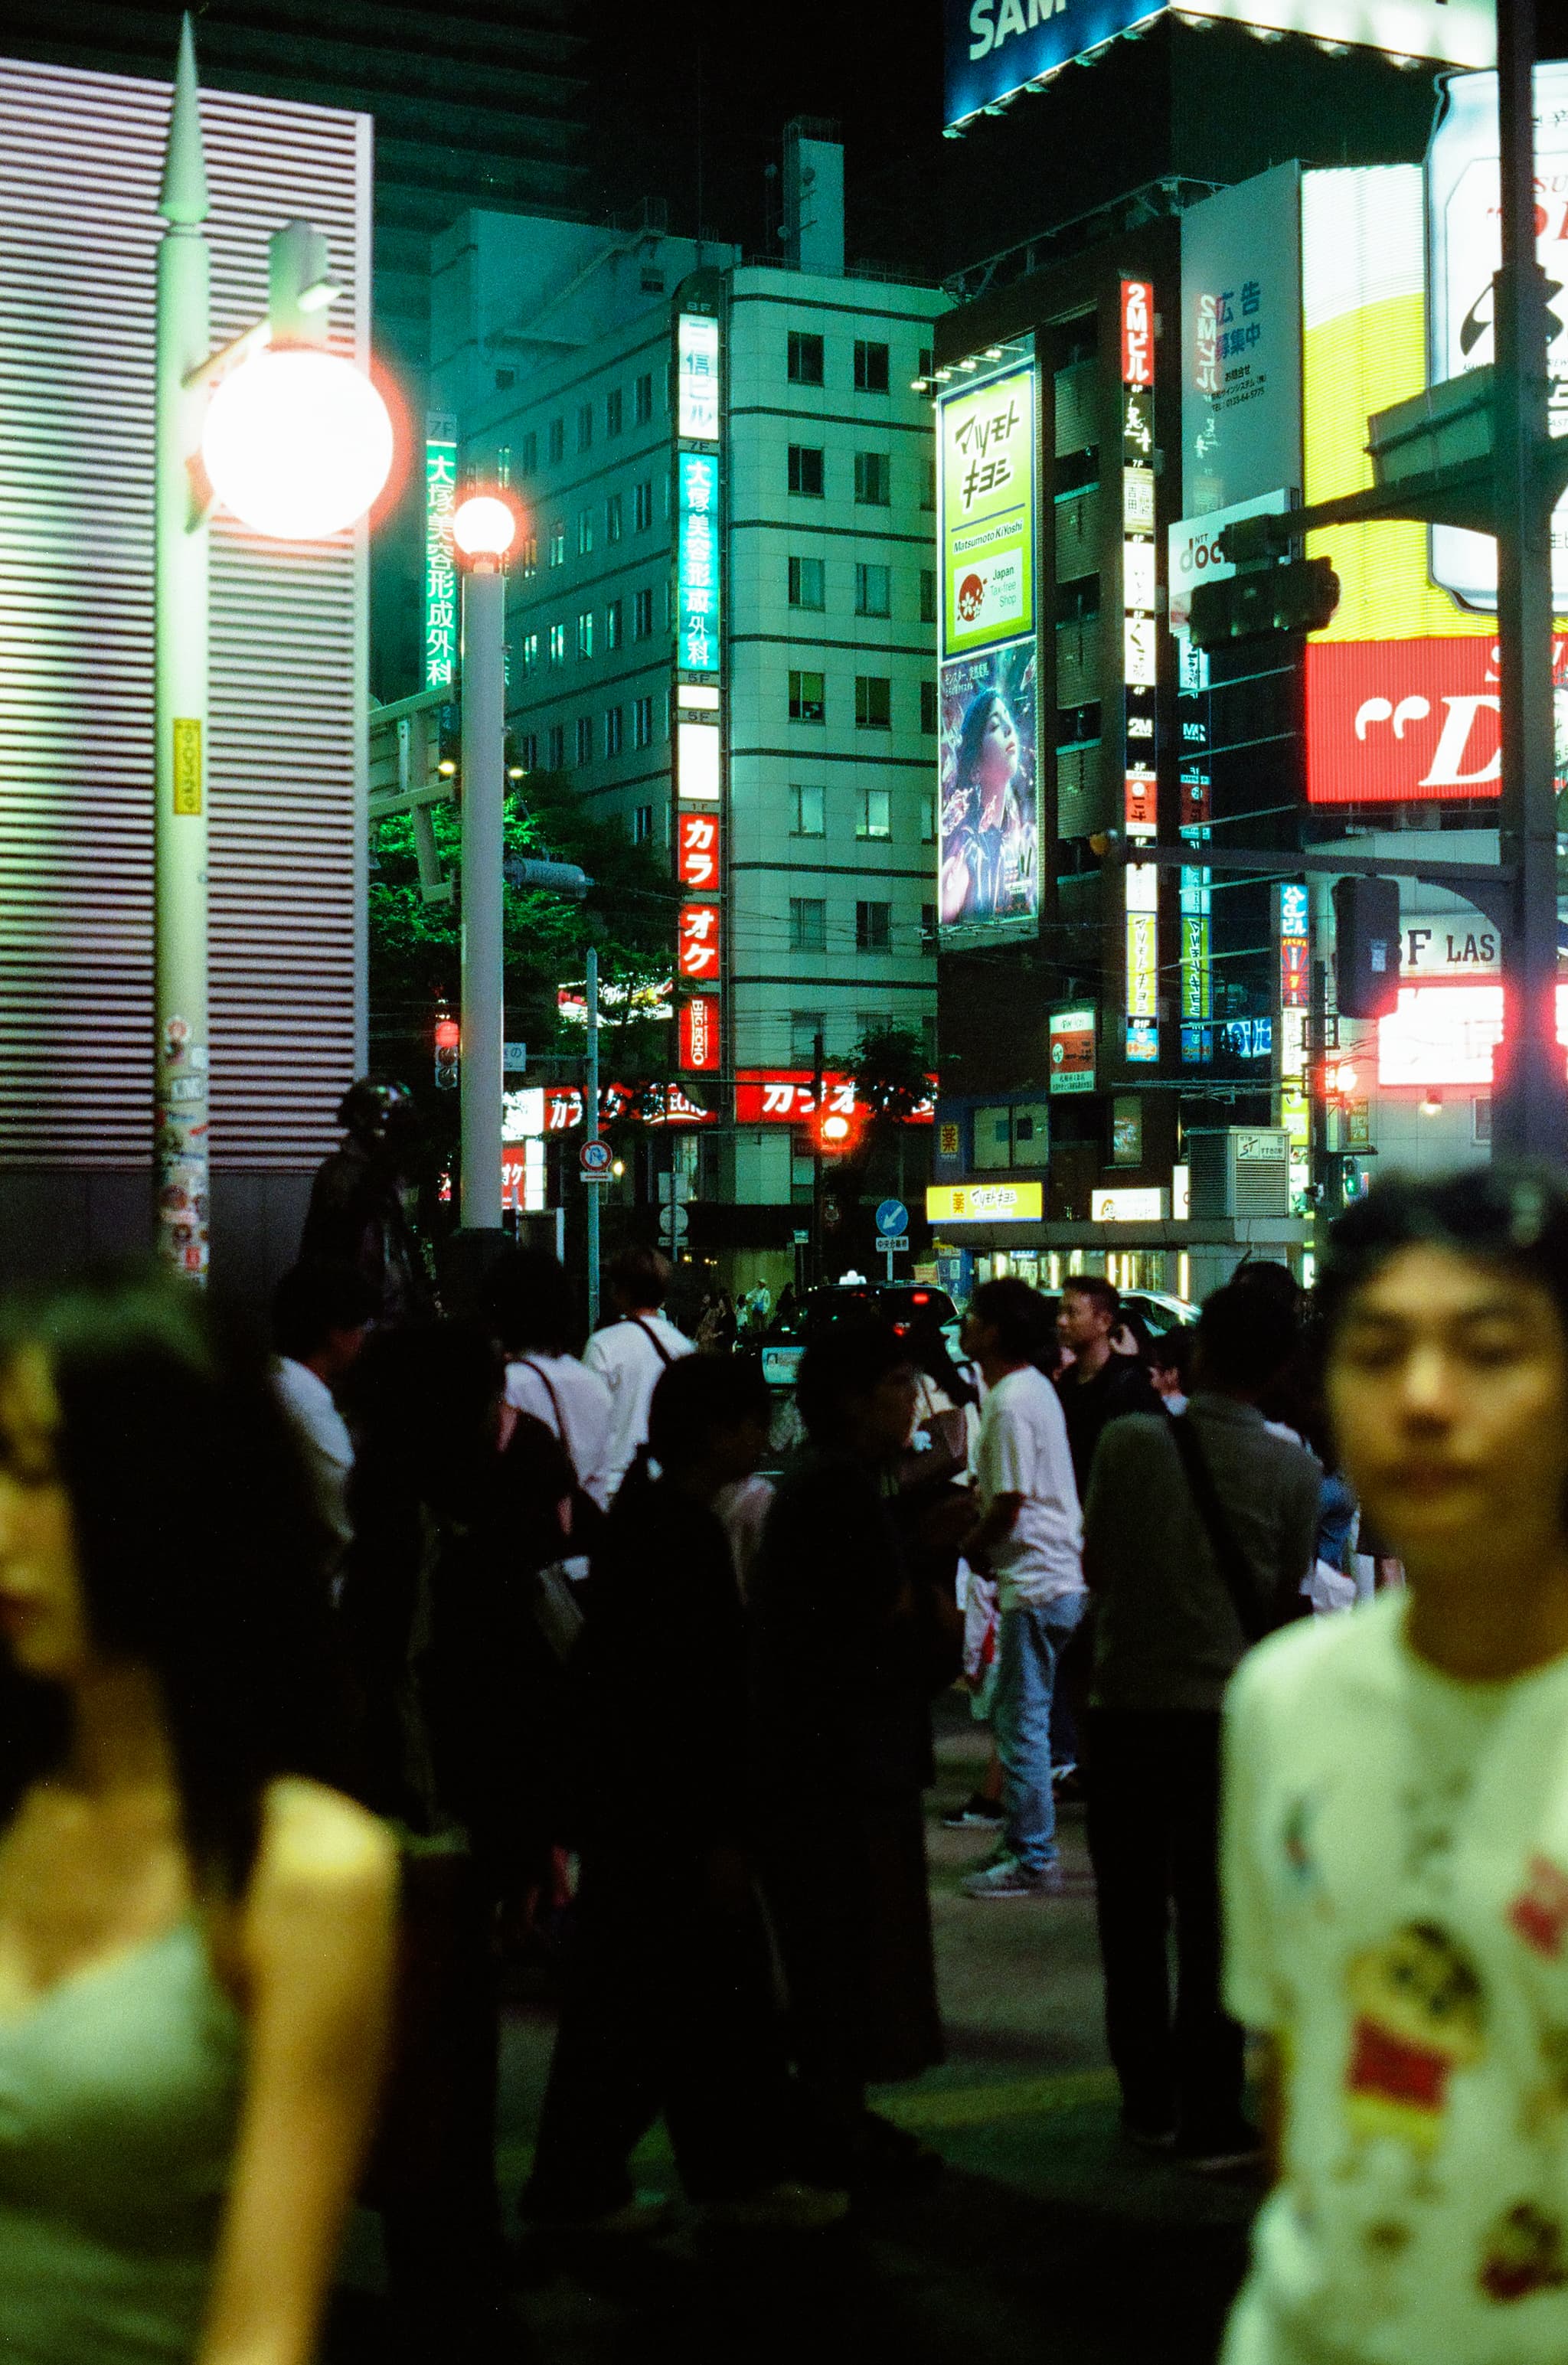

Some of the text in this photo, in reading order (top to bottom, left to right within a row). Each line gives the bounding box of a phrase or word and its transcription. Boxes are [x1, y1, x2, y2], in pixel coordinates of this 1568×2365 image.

[1126, 283, 1149, 381] 2Mビル
[955, 399, 1020, 458] マツモト
[689, 440, 710, 450] 7F
[962, 458, 1012, 509] キヨシ
[954, 532, 995, 552] Matsumoto
[1195, 534, 1208, 544] NTT
[426, 455, 454, 686] 大塚美容形成外科
[685, 462, 711, 666] 大塚美容形成外科
[992, 566, 1015, 582] Japan
[990, 581, 1017, 597] Tax-free
[999, 593, 1017, 608] Shop
[688, 711, 710, 722] 5F
[1135, 919, 1147, 1012] マツモトキヨシ
[692, 1000, 705, 1066] BIG ECHO
[942, 1125, 956, 1151] 薬
[952, 1192, 965, 1213] 薬
[972, 1188, 1016, 1207] マツモトキヨシ
